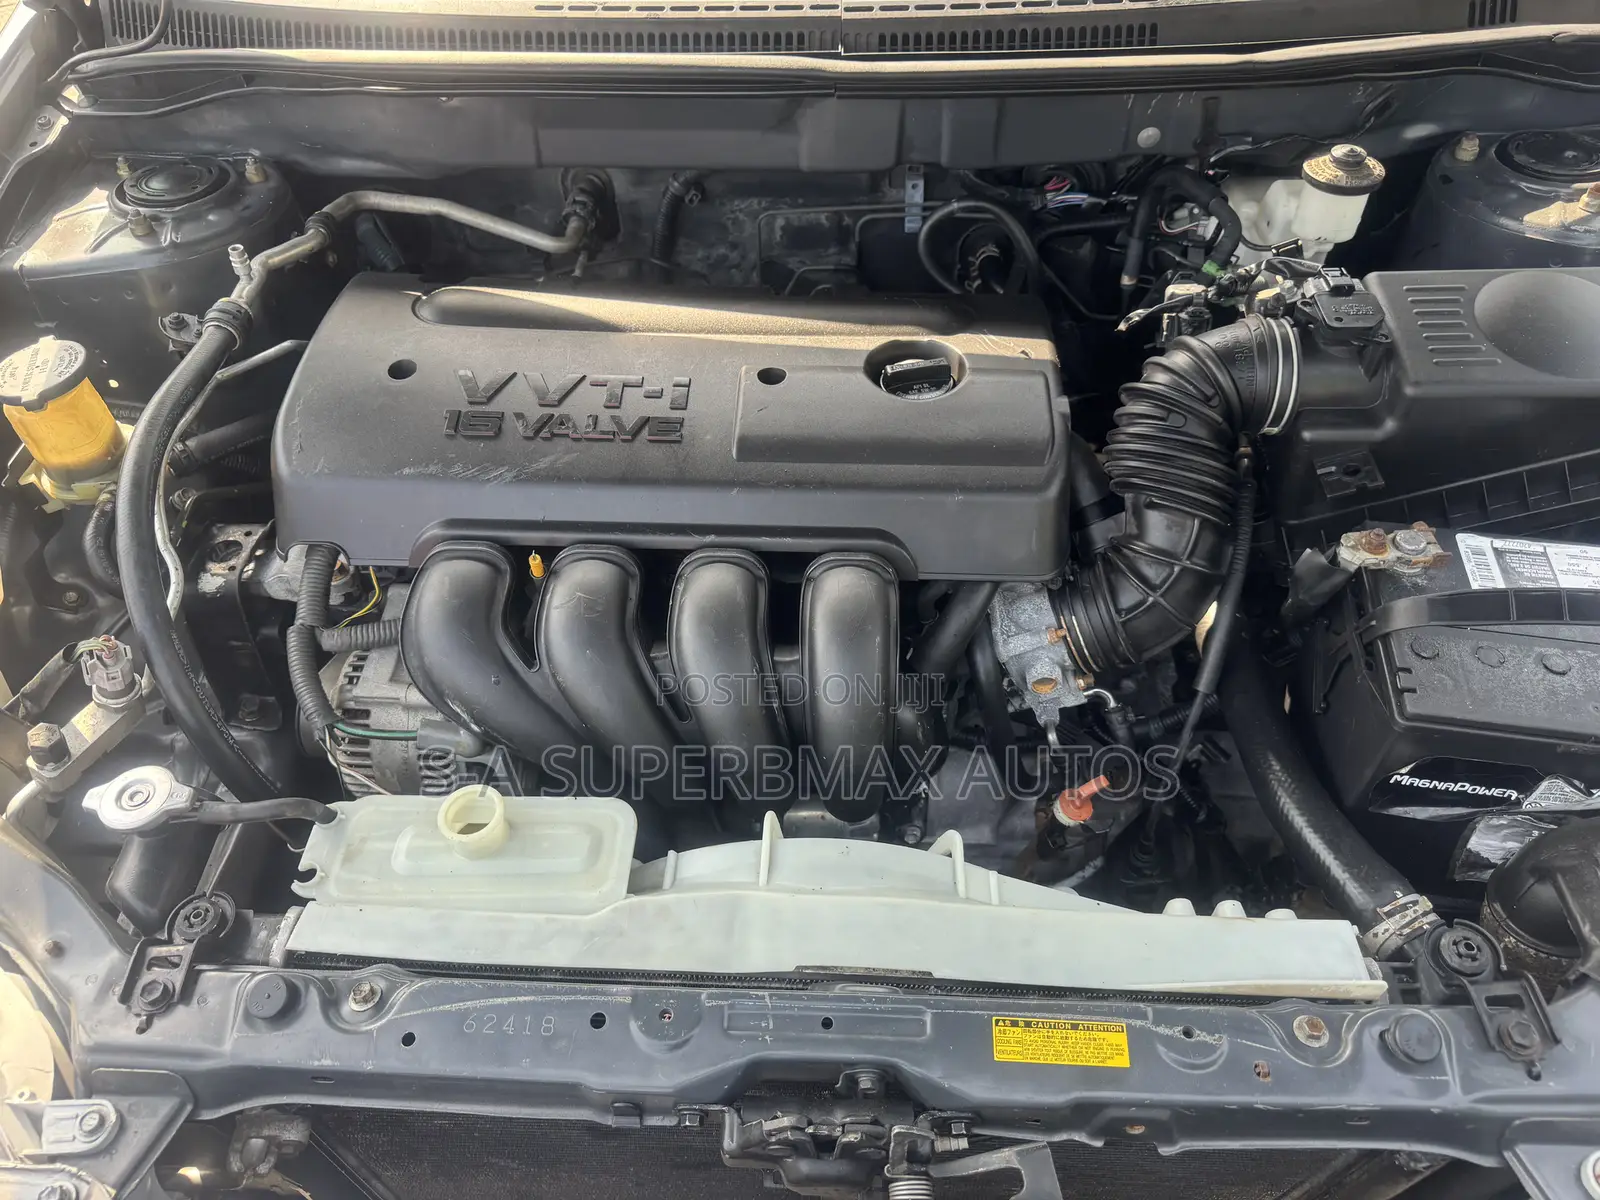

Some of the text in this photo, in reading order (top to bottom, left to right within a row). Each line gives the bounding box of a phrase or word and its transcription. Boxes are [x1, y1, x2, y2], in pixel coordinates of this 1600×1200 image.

[444, 409, 684, 443] 16 VALVE
[463, 1013, 555, 1036] 62418
[1031, 1021, 1122, 1033] CAUTION ATTENTION
